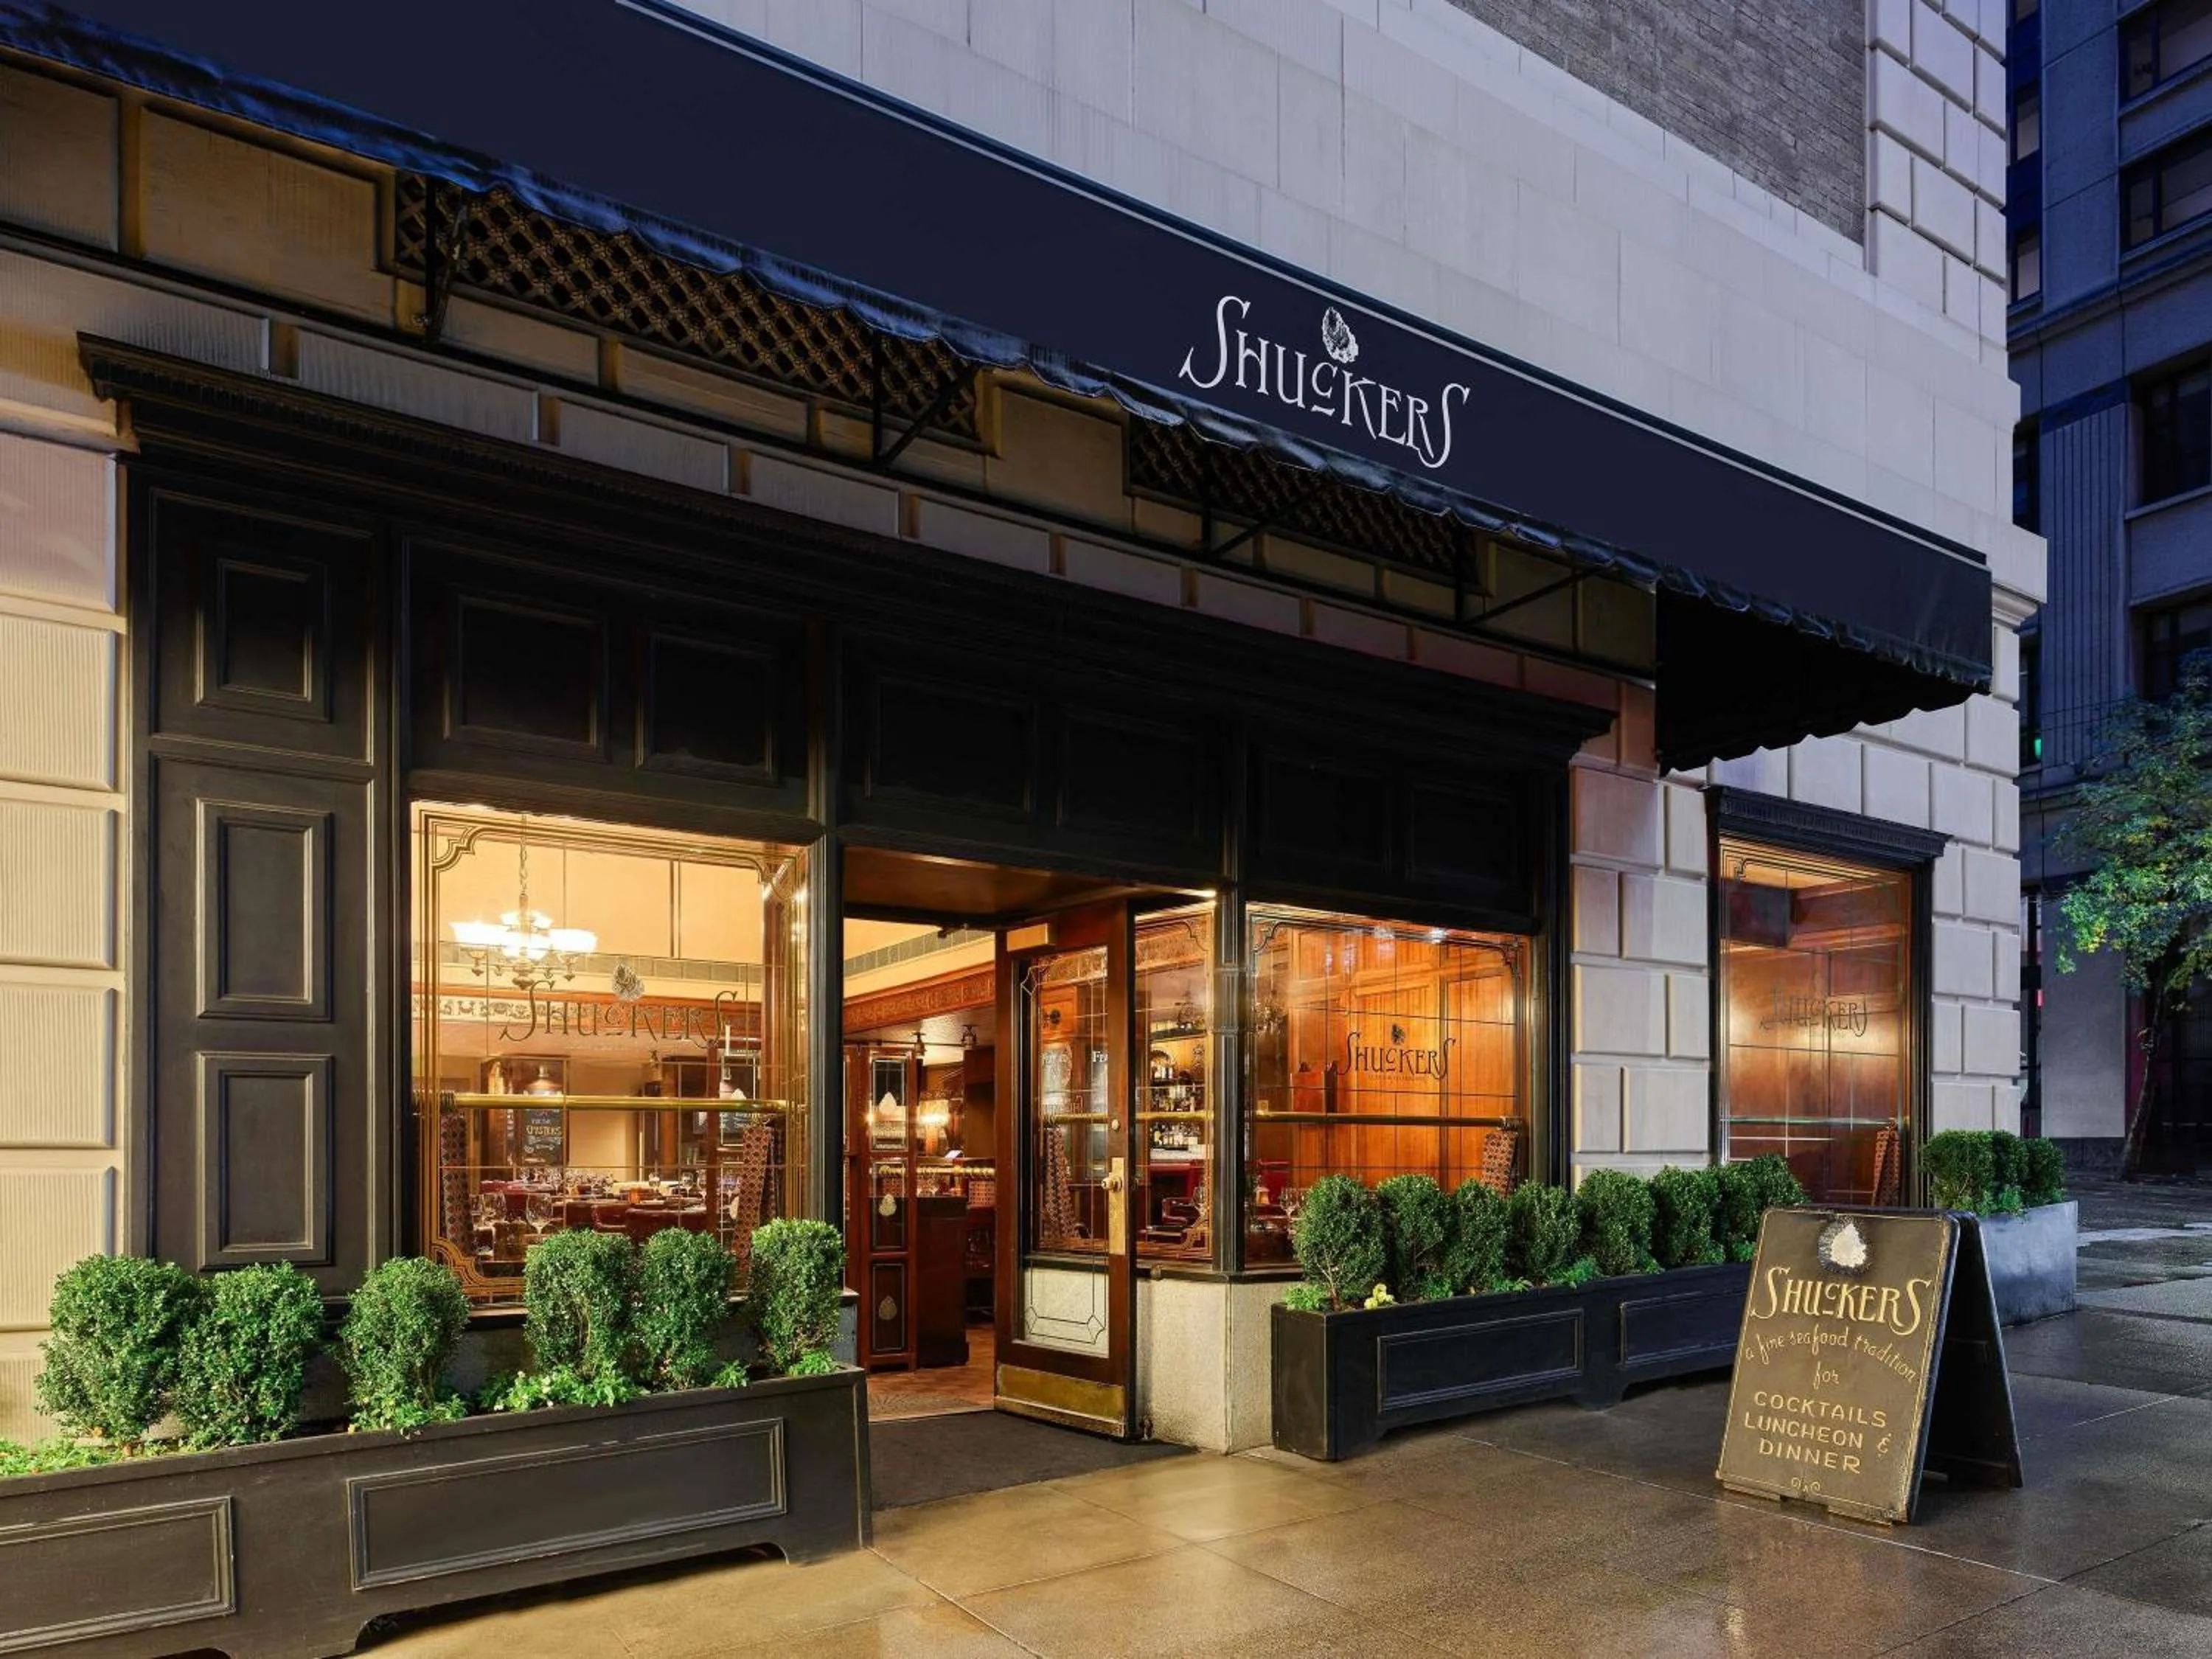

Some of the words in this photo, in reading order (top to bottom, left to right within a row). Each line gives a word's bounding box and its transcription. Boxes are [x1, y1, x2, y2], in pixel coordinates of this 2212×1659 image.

[1179, 295, 1471, 469] SHUCKERS
[499, 980, 738, 1048] SHUCKERS
[1335, 1032, 1456, 1080] SHUCKERS
[1750, 1266, 1931, 1336] SHUCKERS
[1745, 1347, 1755, 1360] a
[1756, 1333, 1785, 1365] fine
[1790, 1324, 1849, 1356] seafood
[1854, 1335, 1918, 1384] tradition
[1813, 1361, 1840, 1390] for
[1744, 1411, 1864, 1450] LUNCHEON
[1754, 1391, 1888, 1428] COCKTAILS
[1759, 1438, 1861, 1475] DINNER
